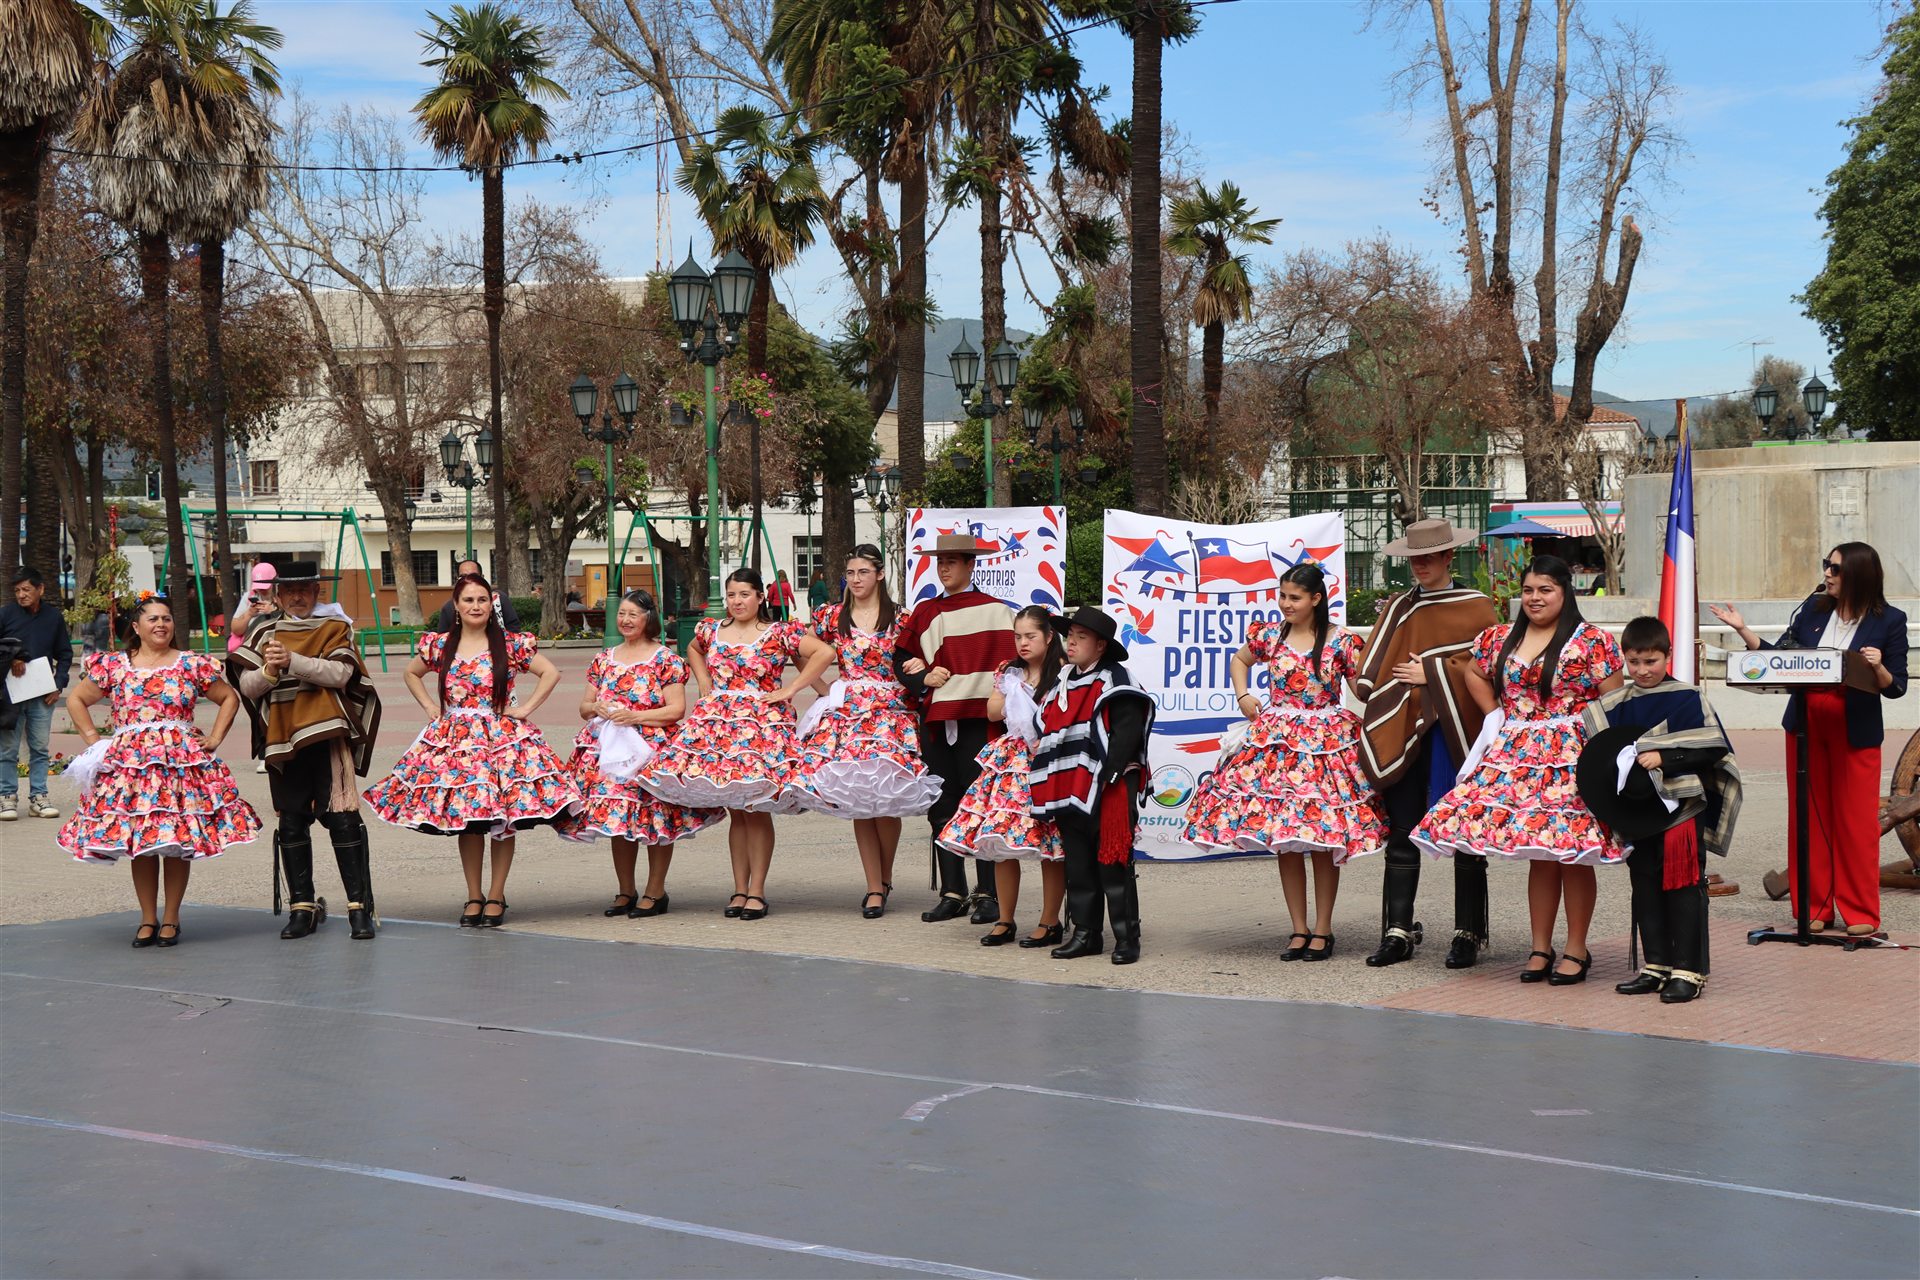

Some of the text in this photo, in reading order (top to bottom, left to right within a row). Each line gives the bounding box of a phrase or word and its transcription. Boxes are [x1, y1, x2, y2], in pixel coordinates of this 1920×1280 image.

[993, 586, 1015, 598] 2026
[1178, 609, 1282, 644] FIEST
[1769, 655, 1831, 670] Quillota
[1147, 692, 1241, 711] QUILLOT
[1138, 815, 1186, 830] nstruy
